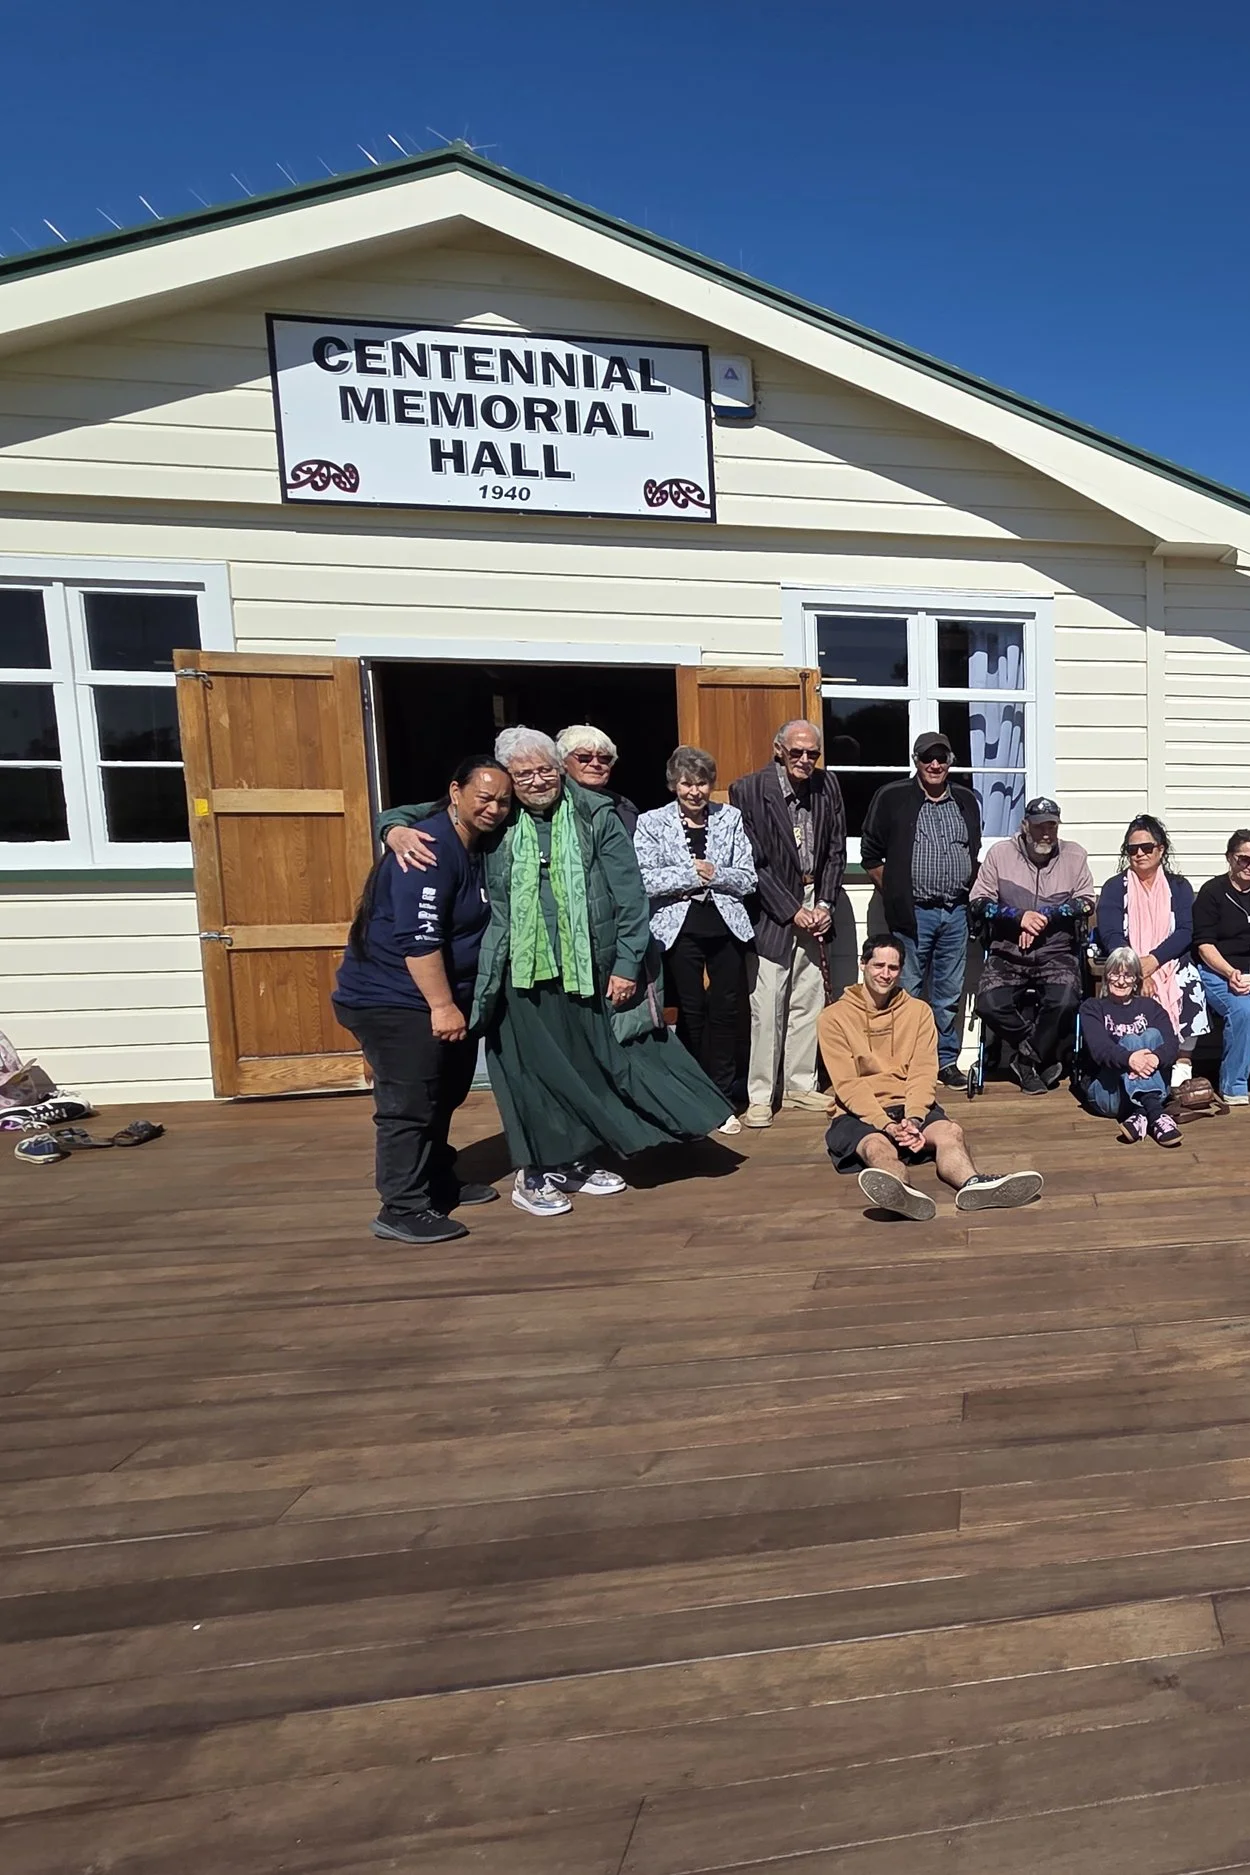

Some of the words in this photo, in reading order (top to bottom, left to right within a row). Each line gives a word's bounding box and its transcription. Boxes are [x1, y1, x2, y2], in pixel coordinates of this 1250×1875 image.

[312, 335, 669, 394] CENTENNIAL
[339, 385, 652, 439] MEMORIAL
[430, 438, 574, 480] HALL
[478, 484, 531, 502] 1940
